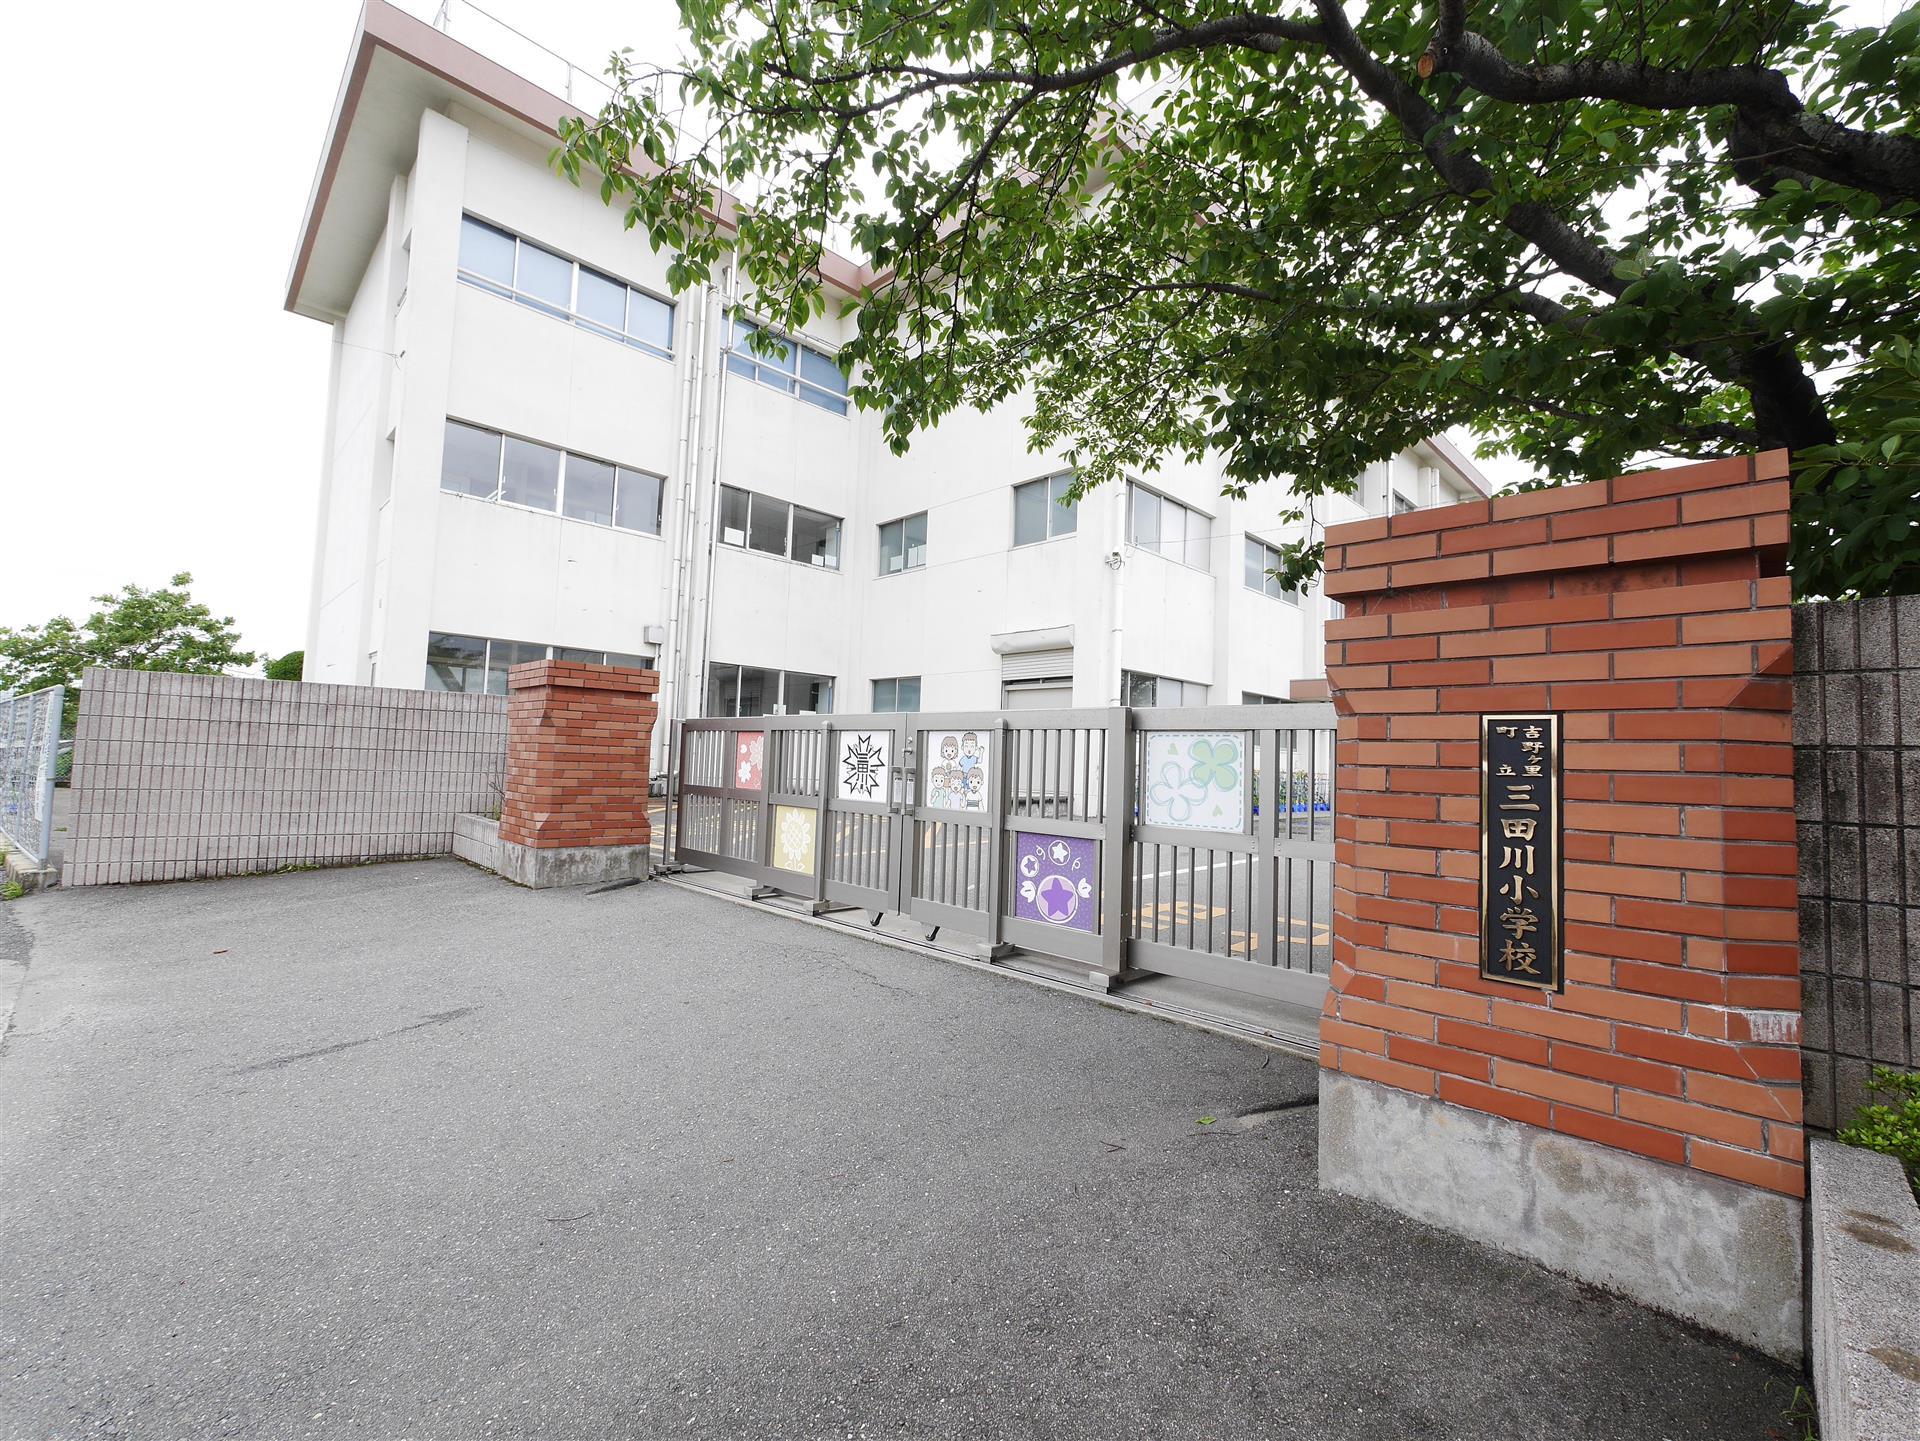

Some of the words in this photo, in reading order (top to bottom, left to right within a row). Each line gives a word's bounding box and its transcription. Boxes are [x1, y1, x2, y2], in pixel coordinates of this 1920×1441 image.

[1499, 784, 1541, 975] 三田川小学校
